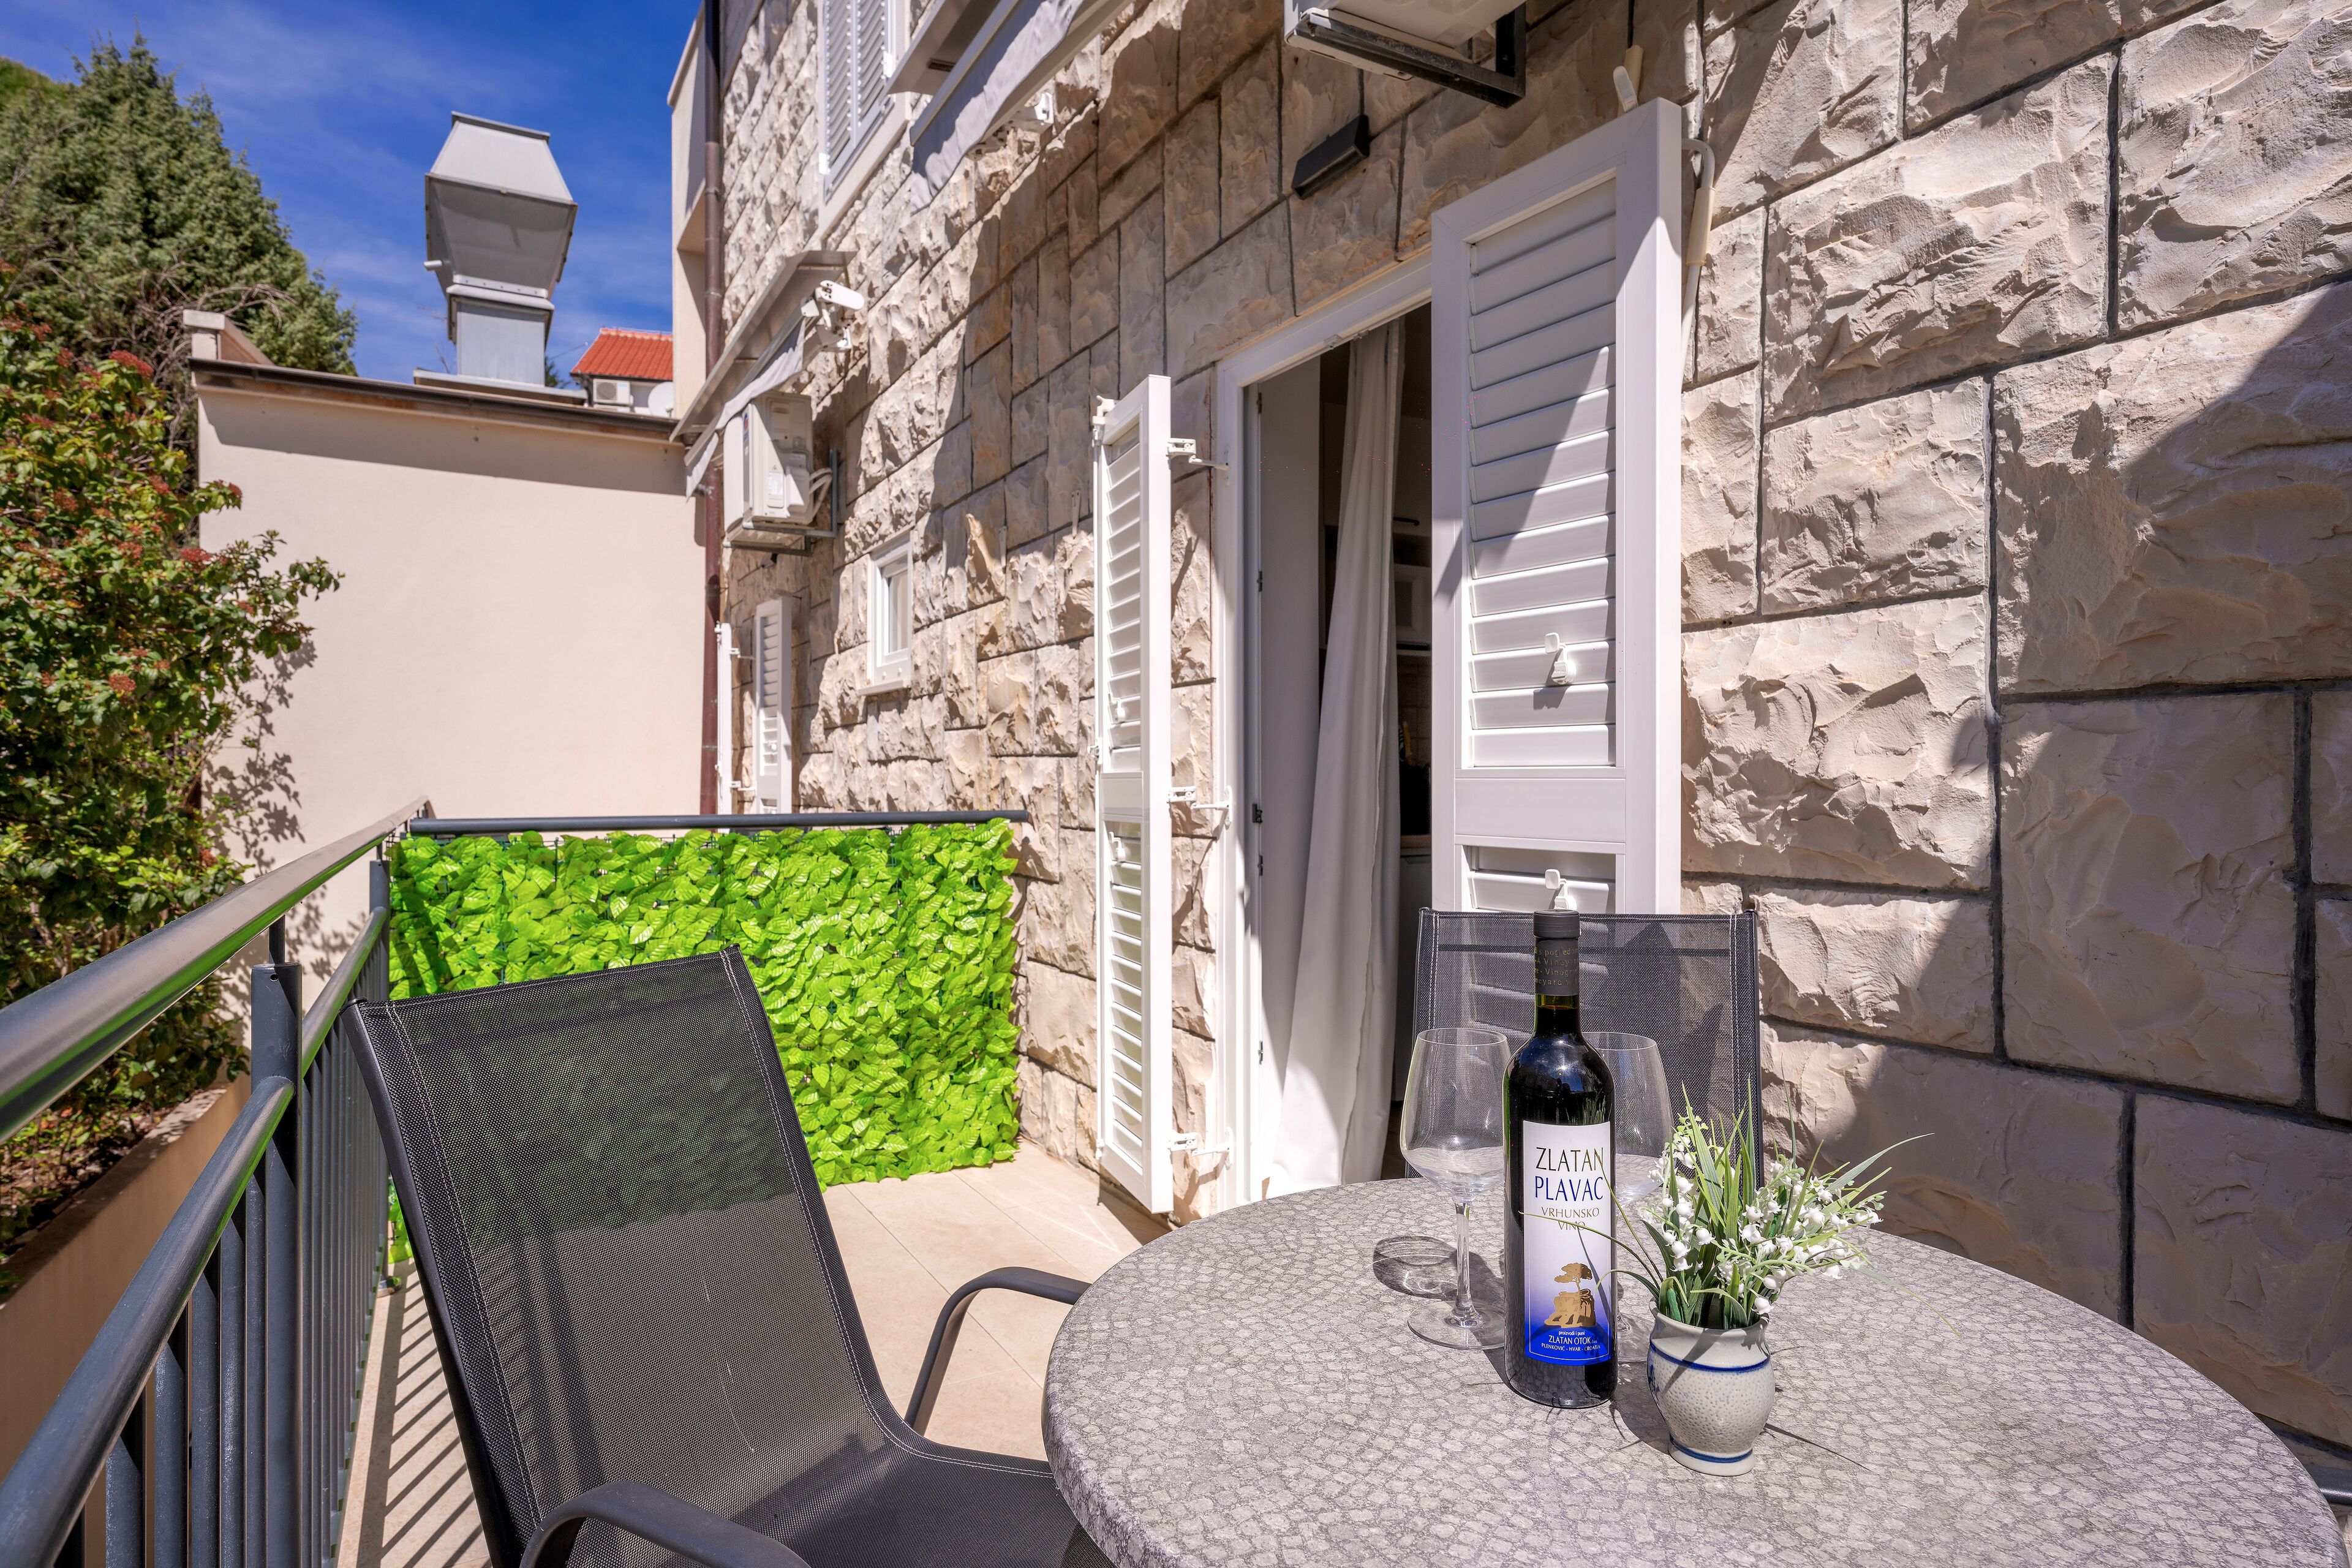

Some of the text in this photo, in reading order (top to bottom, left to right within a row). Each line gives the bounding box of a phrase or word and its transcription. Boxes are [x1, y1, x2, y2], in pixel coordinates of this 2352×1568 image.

[1536, 1147, 1604, 1172] ZLATAN
[1535, 1175, 1604, 1201] PLAVAC
[1541, 1206, 1600, 1218] VRHUNSKO
[1558, 1221, 1585, 1231] VINO
[1548, 1335, 1572, 1344] ZLATAN
[1541, 1343, 1566, 1351] PLENKOVIĆ
